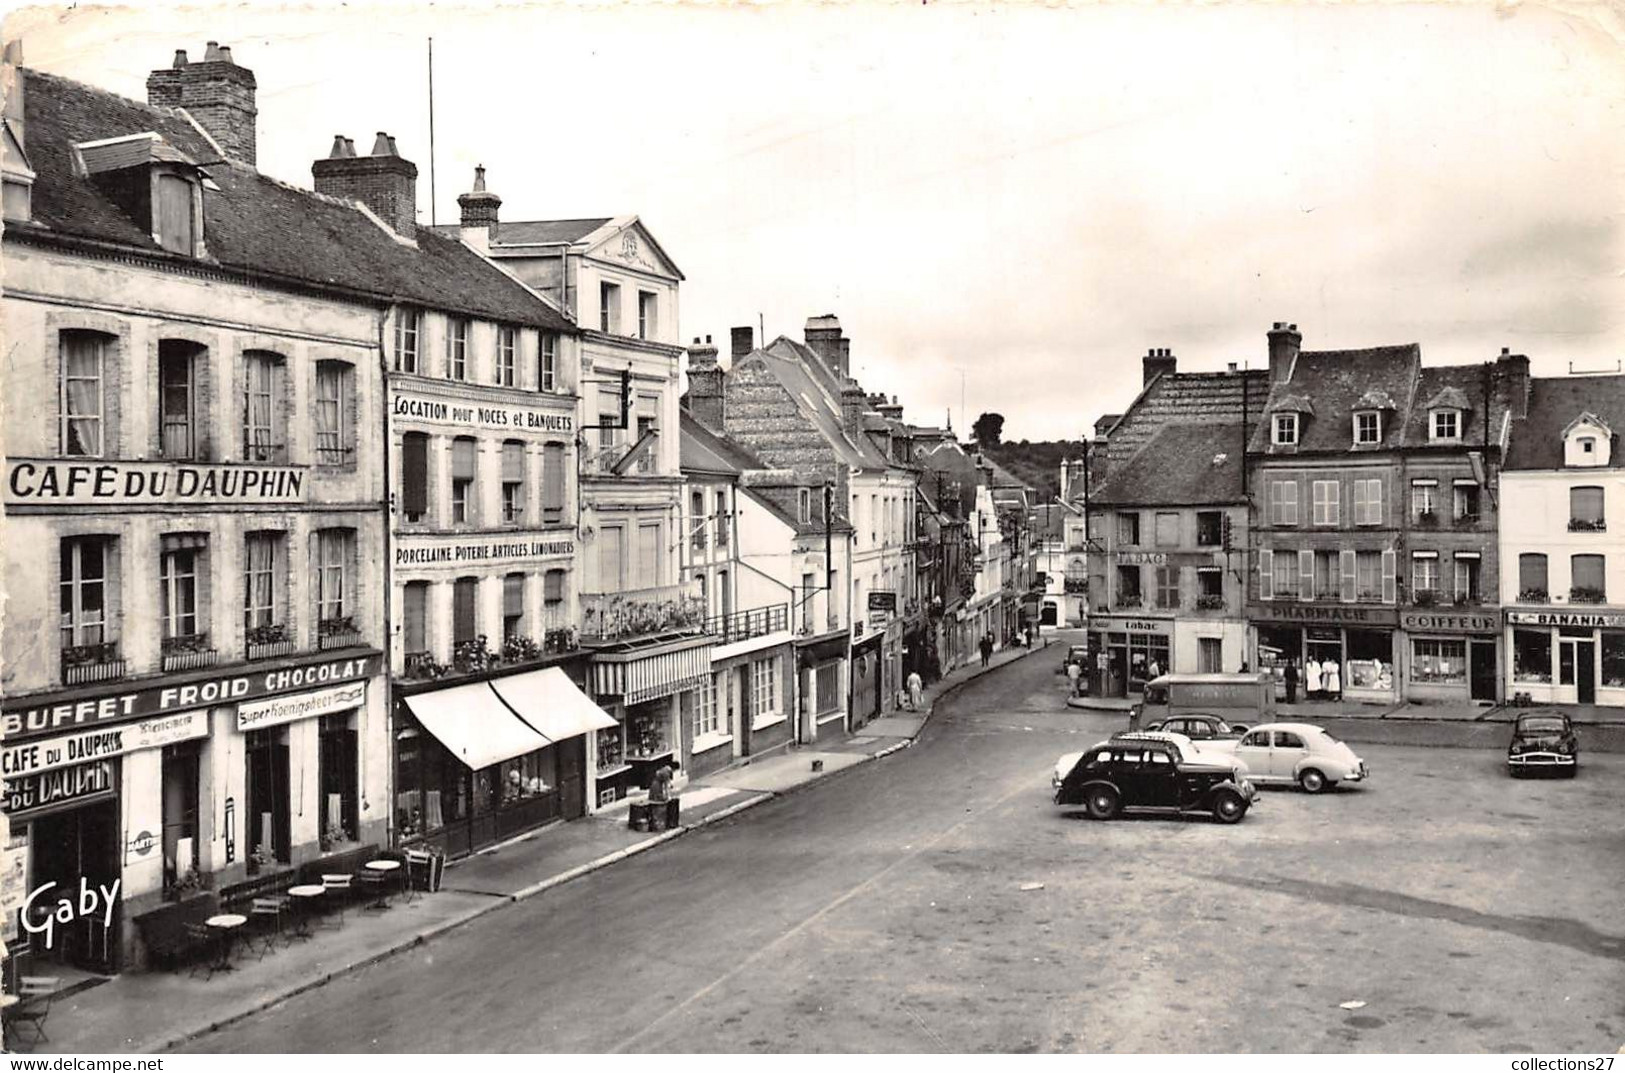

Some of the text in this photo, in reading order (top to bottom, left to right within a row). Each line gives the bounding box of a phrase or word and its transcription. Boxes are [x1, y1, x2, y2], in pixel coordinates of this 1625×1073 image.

[393, 395, 448, 420] LOCATION
[478, 407, 507, 425] NOCES
[513, 413, 522, 426] et
[527, 412, 572, 430] BANQUETS
[124, 471, 167, 497] DU
[176, 469, 303, 497] DAUPHIN
[396, 547, 451, 565] PORCELAINE
[455, 545, 488, 560] POTERIE
[1272, 606, 1369, 621] PHARMACIE
[1405, 615, 1496, 629] COIFFEUR
[1538, 614, 1605, 626] BANANIA
[1126, 621, 1158, 631] tabac
[2, 695, 138, 734] BUFFET
[160, 678, 250, 709] FROID
[265, 659, 367, 691] CHOCOLAT
[47, 749, 61, 765] DU
[69, 730, 123, 761] DAUPHIN
[11, 792, 34, 810] DU
